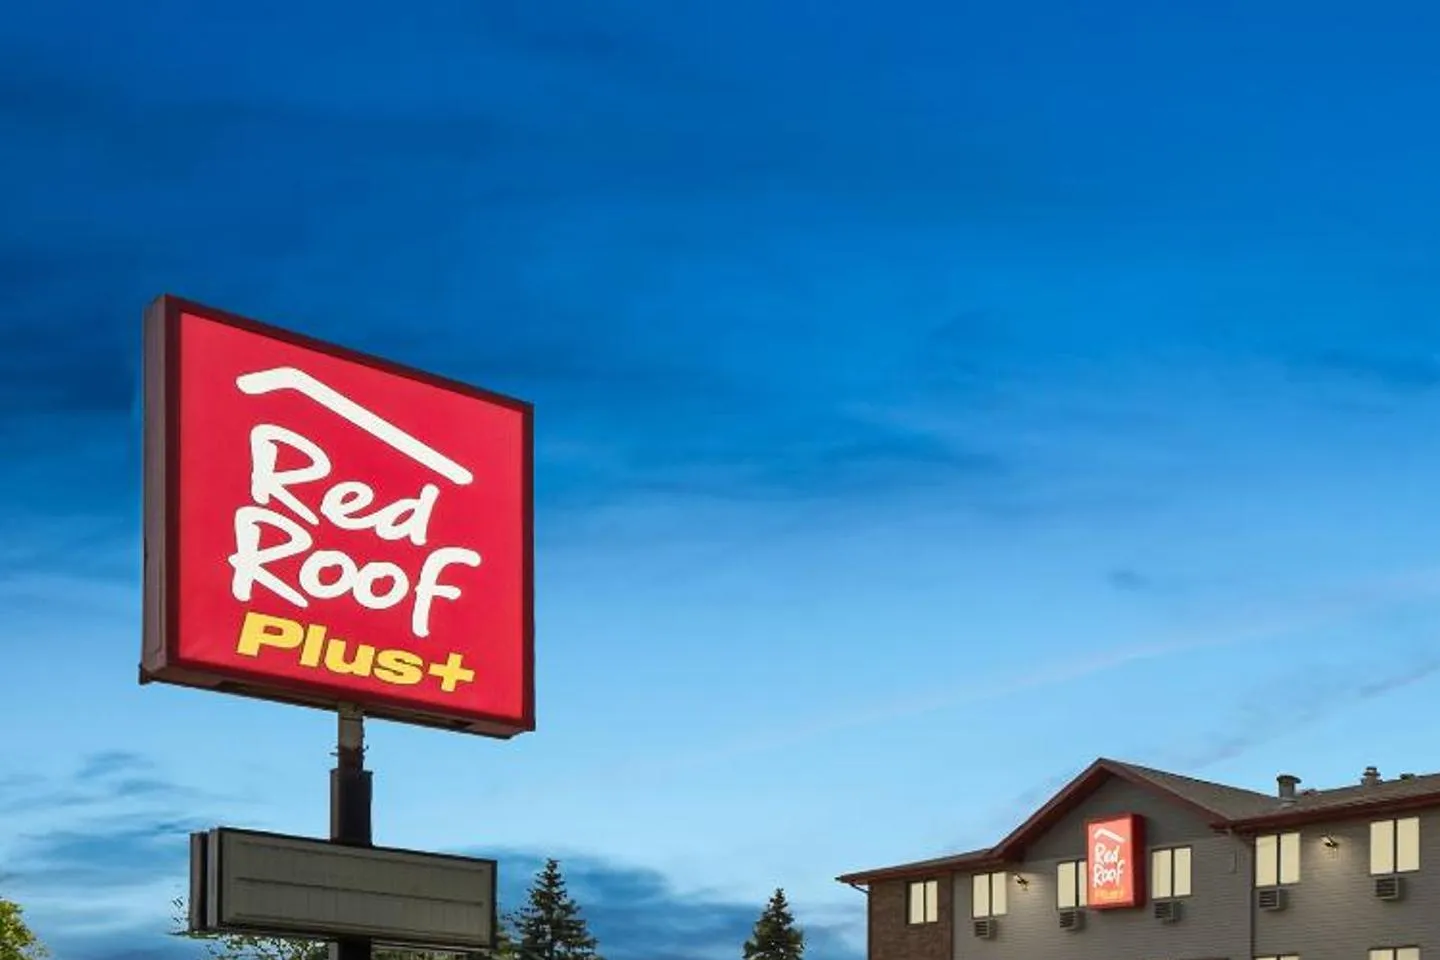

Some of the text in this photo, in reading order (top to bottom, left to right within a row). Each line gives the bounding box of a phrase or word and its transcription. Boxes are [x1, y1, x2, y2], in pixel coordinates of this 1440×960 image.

[250, 424, 439, 545] Red
[228, 506, 481, 637] Roof
[237, 612, 475, 691] Plus+
[1093, 859, 1125, 888] Roof
[1095, 842, 1120, 864] Red
